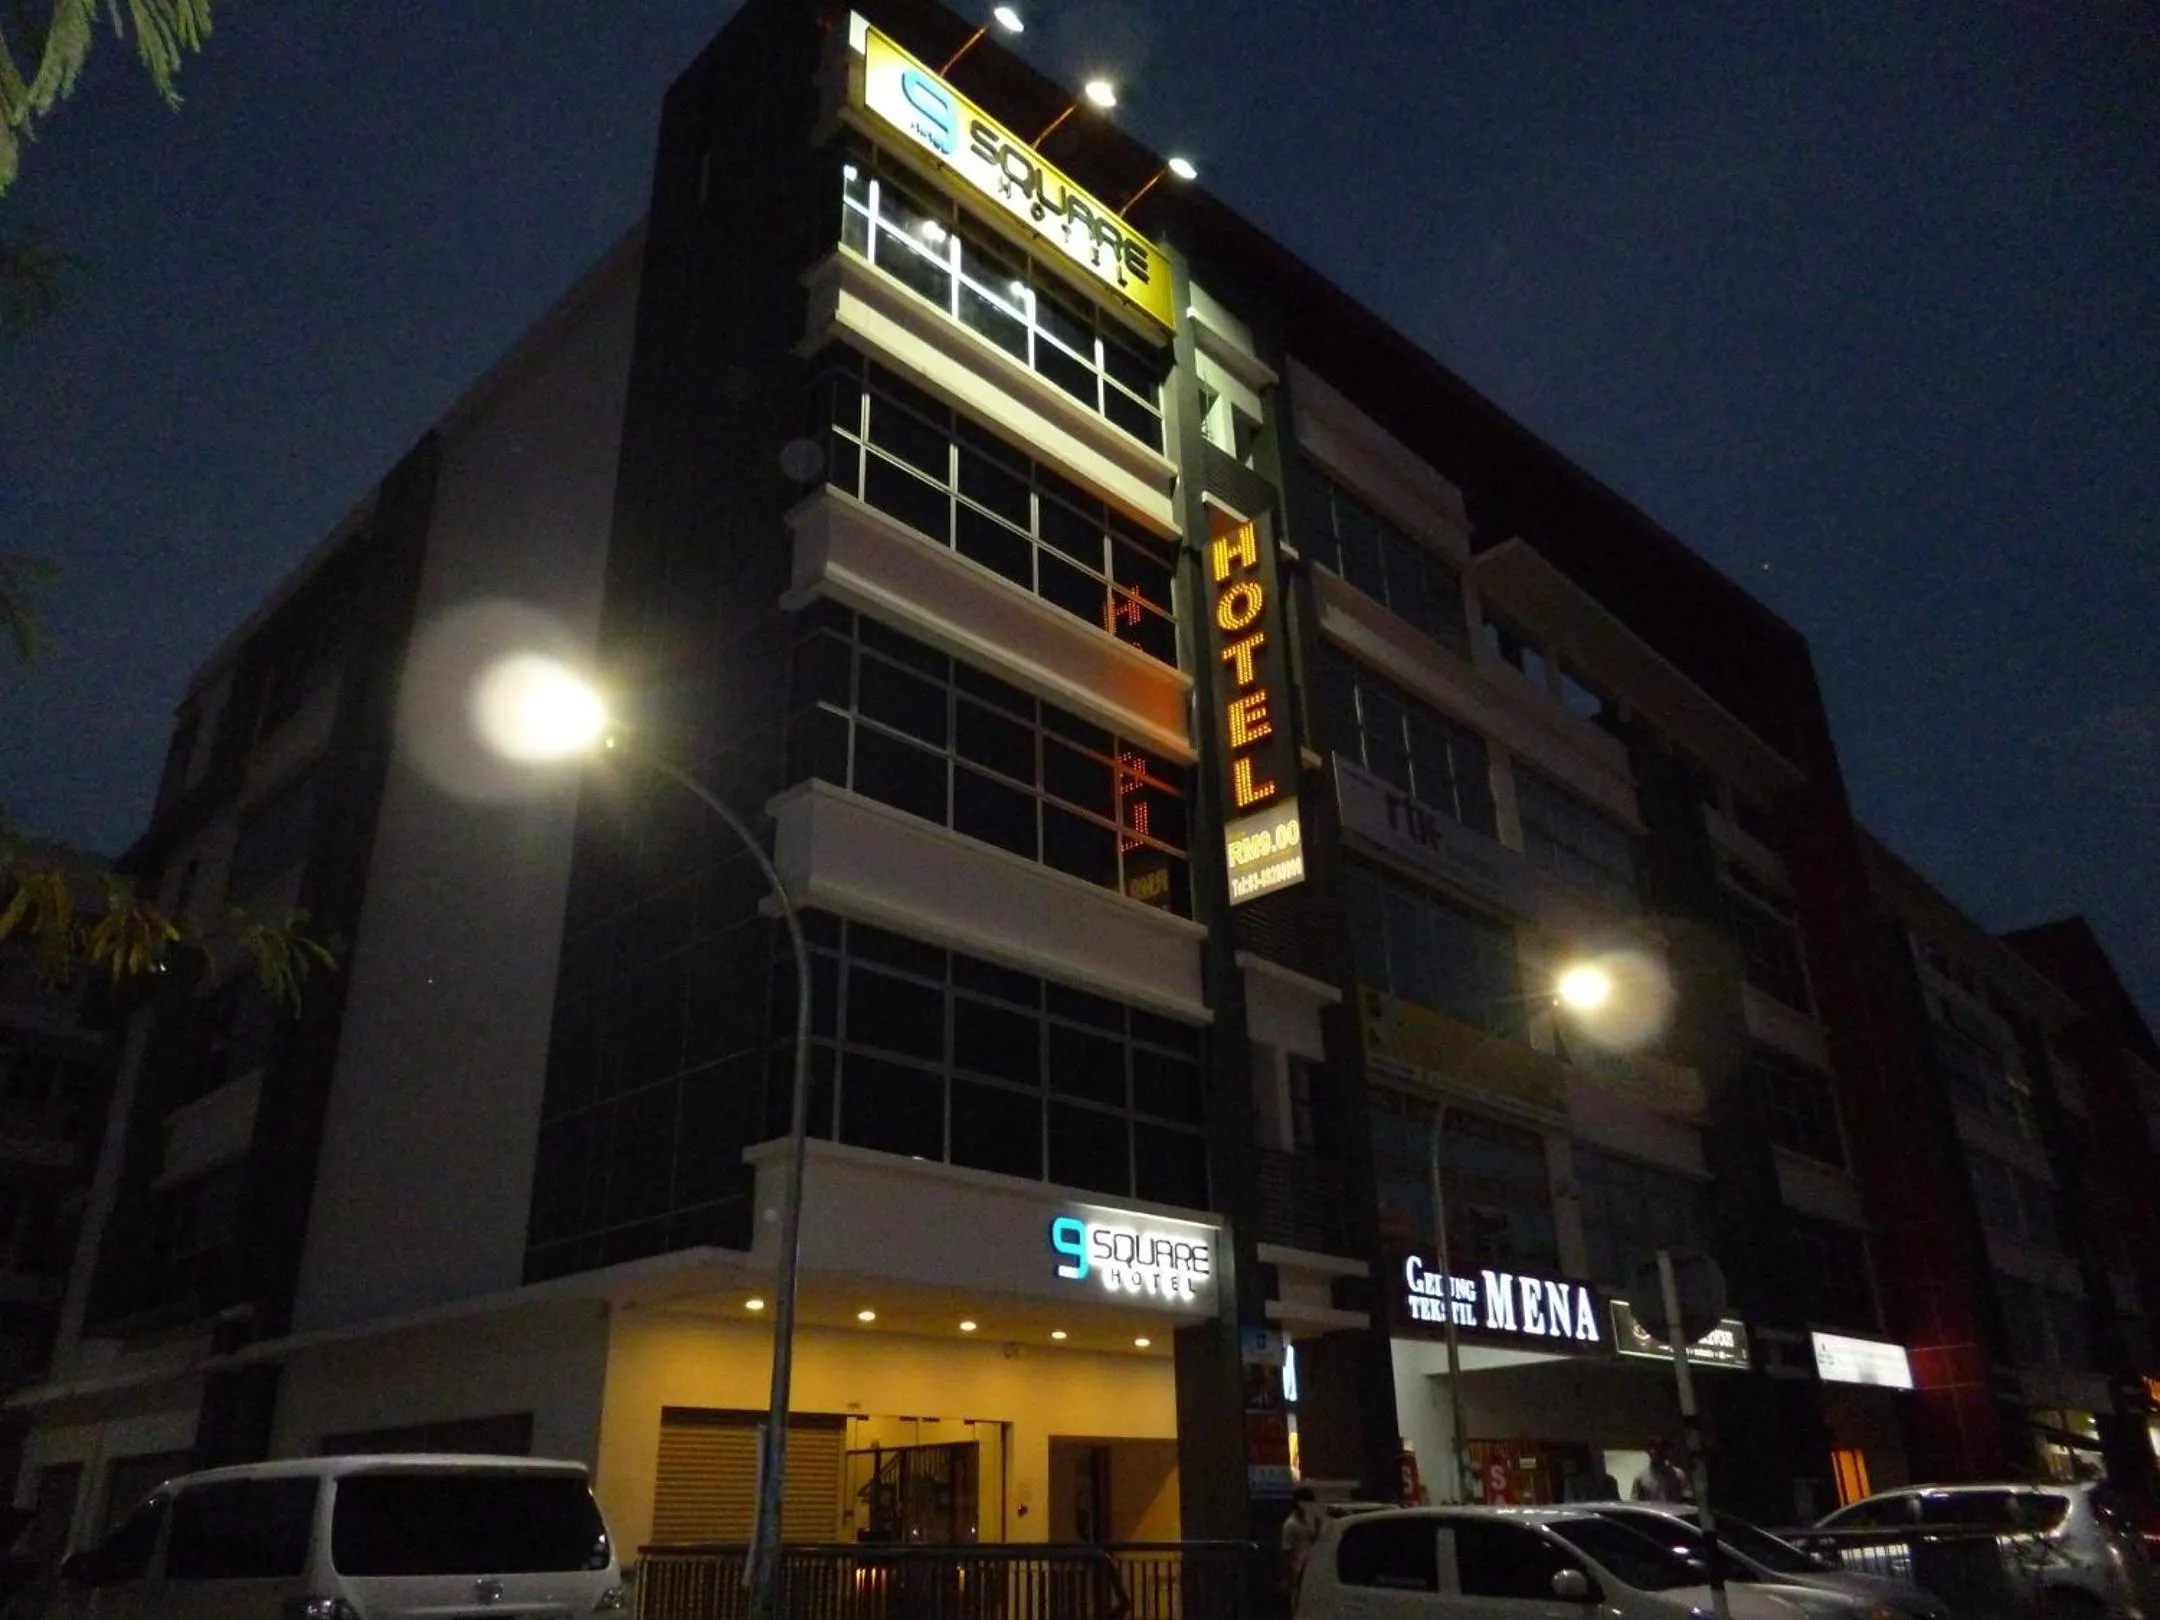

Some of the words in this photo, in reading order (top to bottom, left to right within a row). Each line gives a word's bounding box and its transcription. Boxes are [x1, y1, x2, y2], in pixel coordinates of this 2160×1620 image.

[970, 118, 1150, 286] SQUARE
[998, 176, 1128, 289] HOTEL
[1211, 520, 1277, 808] HOTEL
[1050, 1216, 1090, 1280] 9
[1093, 1229, 1210, 1276] SQUARE
[1110, 1268, 1196, 1293] HOTEL
[1480, 1269, 1600, 1342] MENA
